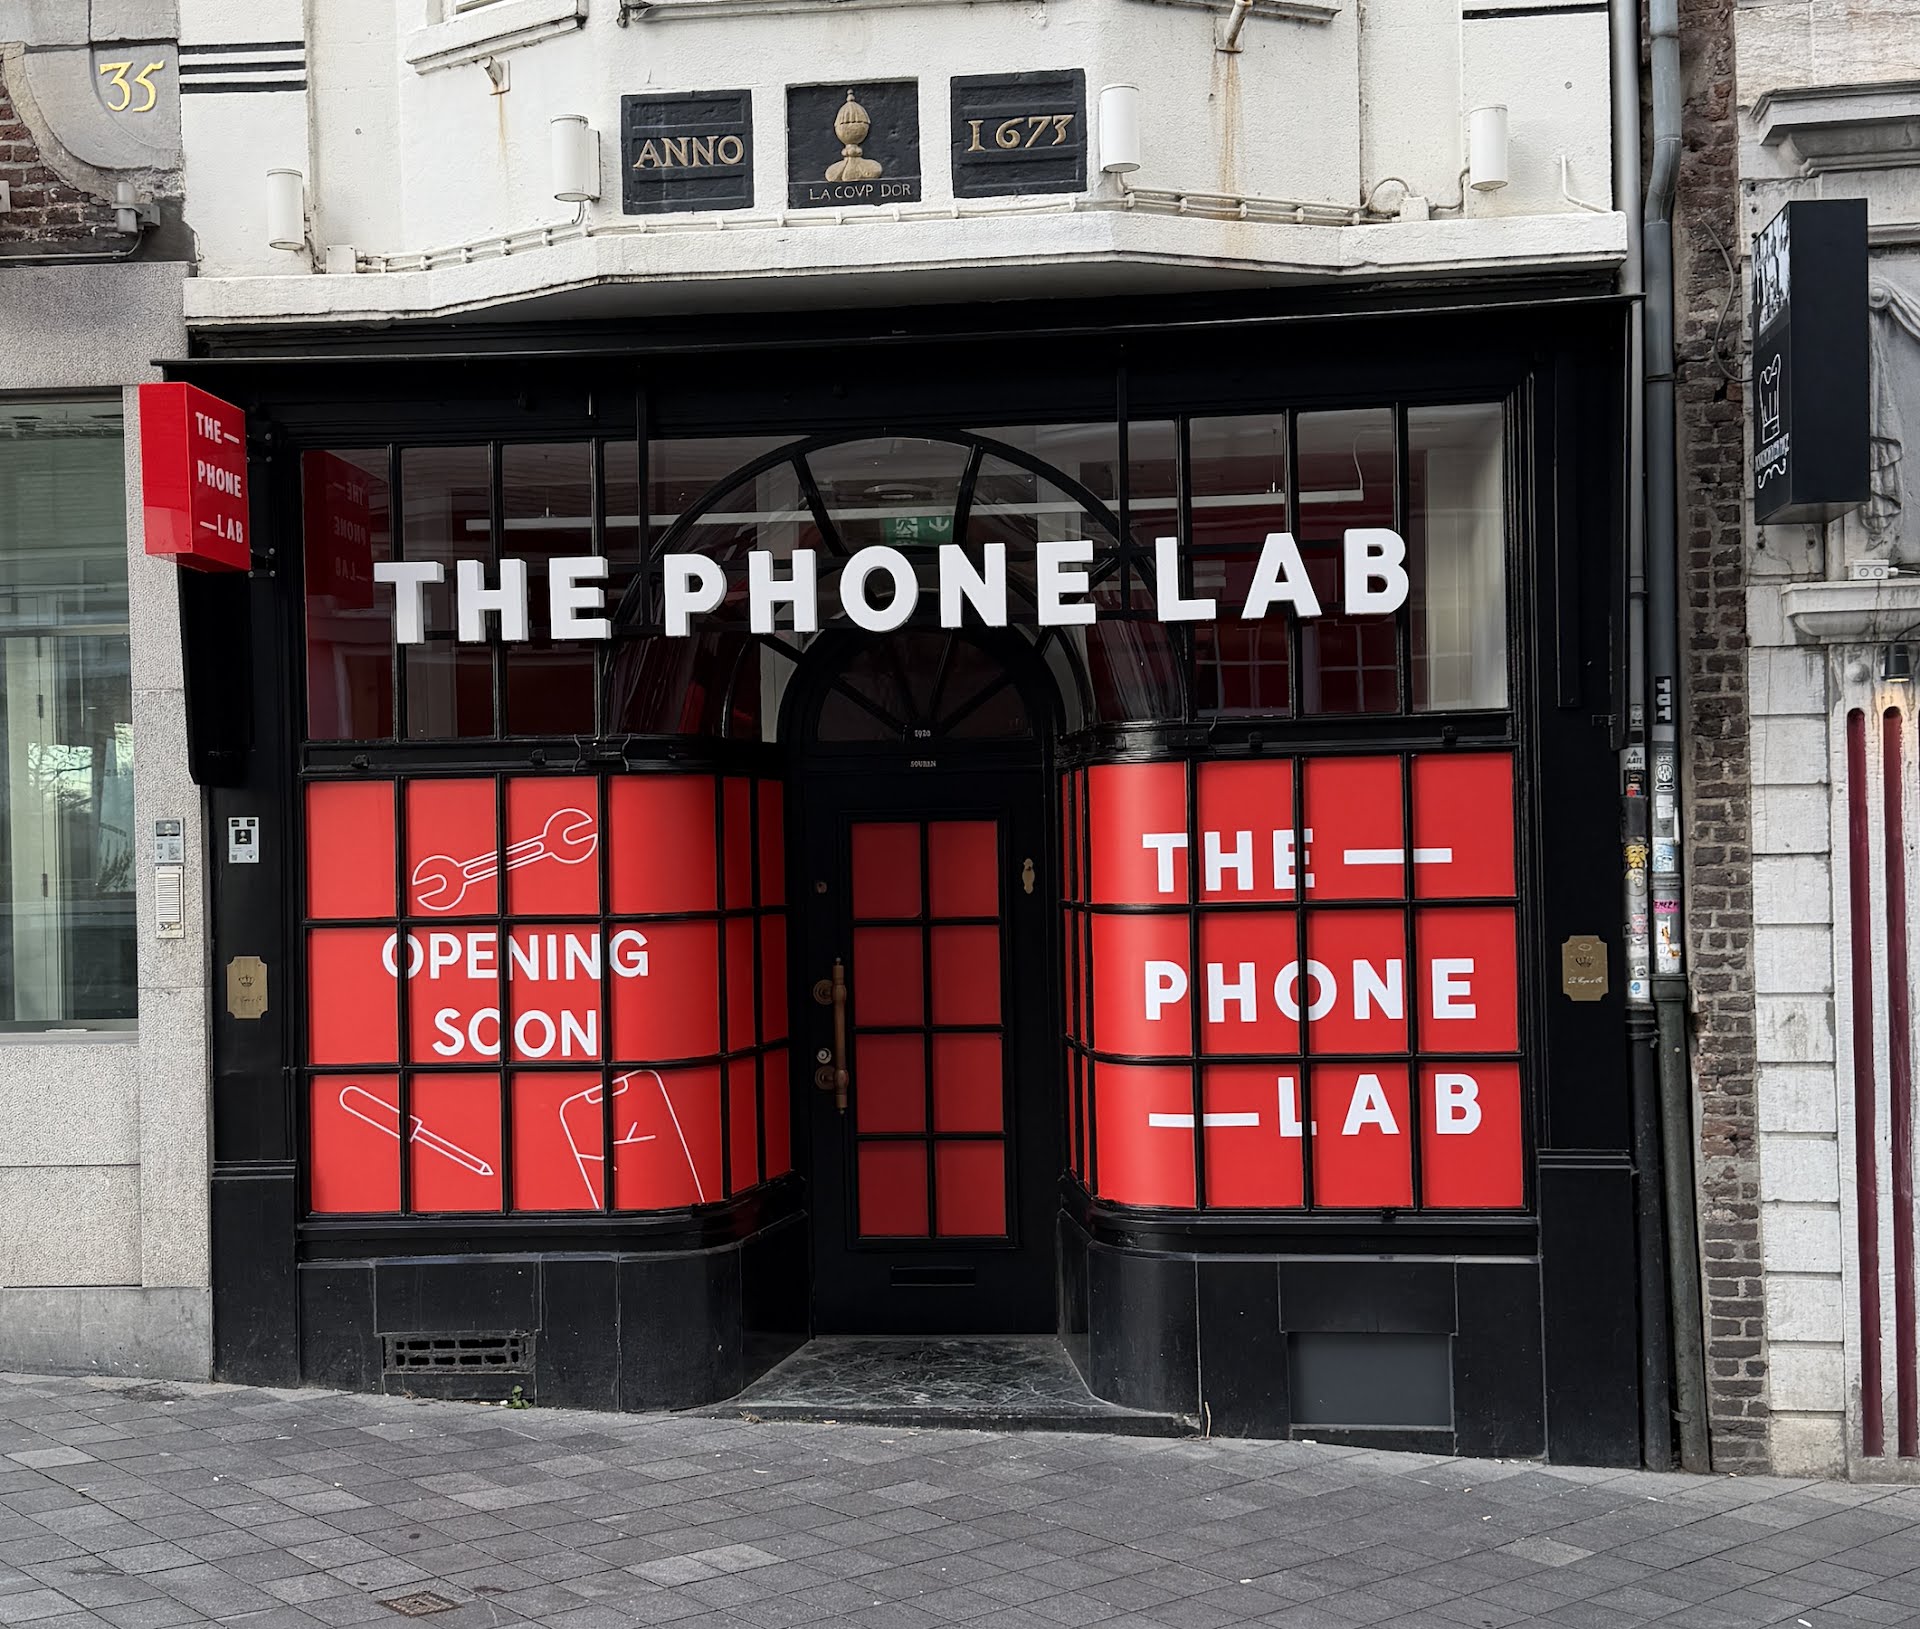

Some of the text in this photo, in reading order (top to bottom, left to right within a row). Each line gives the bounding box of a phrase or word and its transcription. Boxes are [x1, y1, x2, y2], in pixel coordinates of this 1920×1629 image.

[99, 60, 165, 113] 35
[632, 134, 745, 169] ANNO
[967, 113, 1075, 152] 1673
[809, 188, 832, 201] LA
[835, 184, 874, 199] COVP
[197, 459, 243, 499] PHONE
[374, 527, 1411, 645] THE PHONE LAB
[382, 929, 649, 982] OPENING
[1144, 958, 1477, 1023] PHONE
[432, 1007, 598, 1058] SOON
